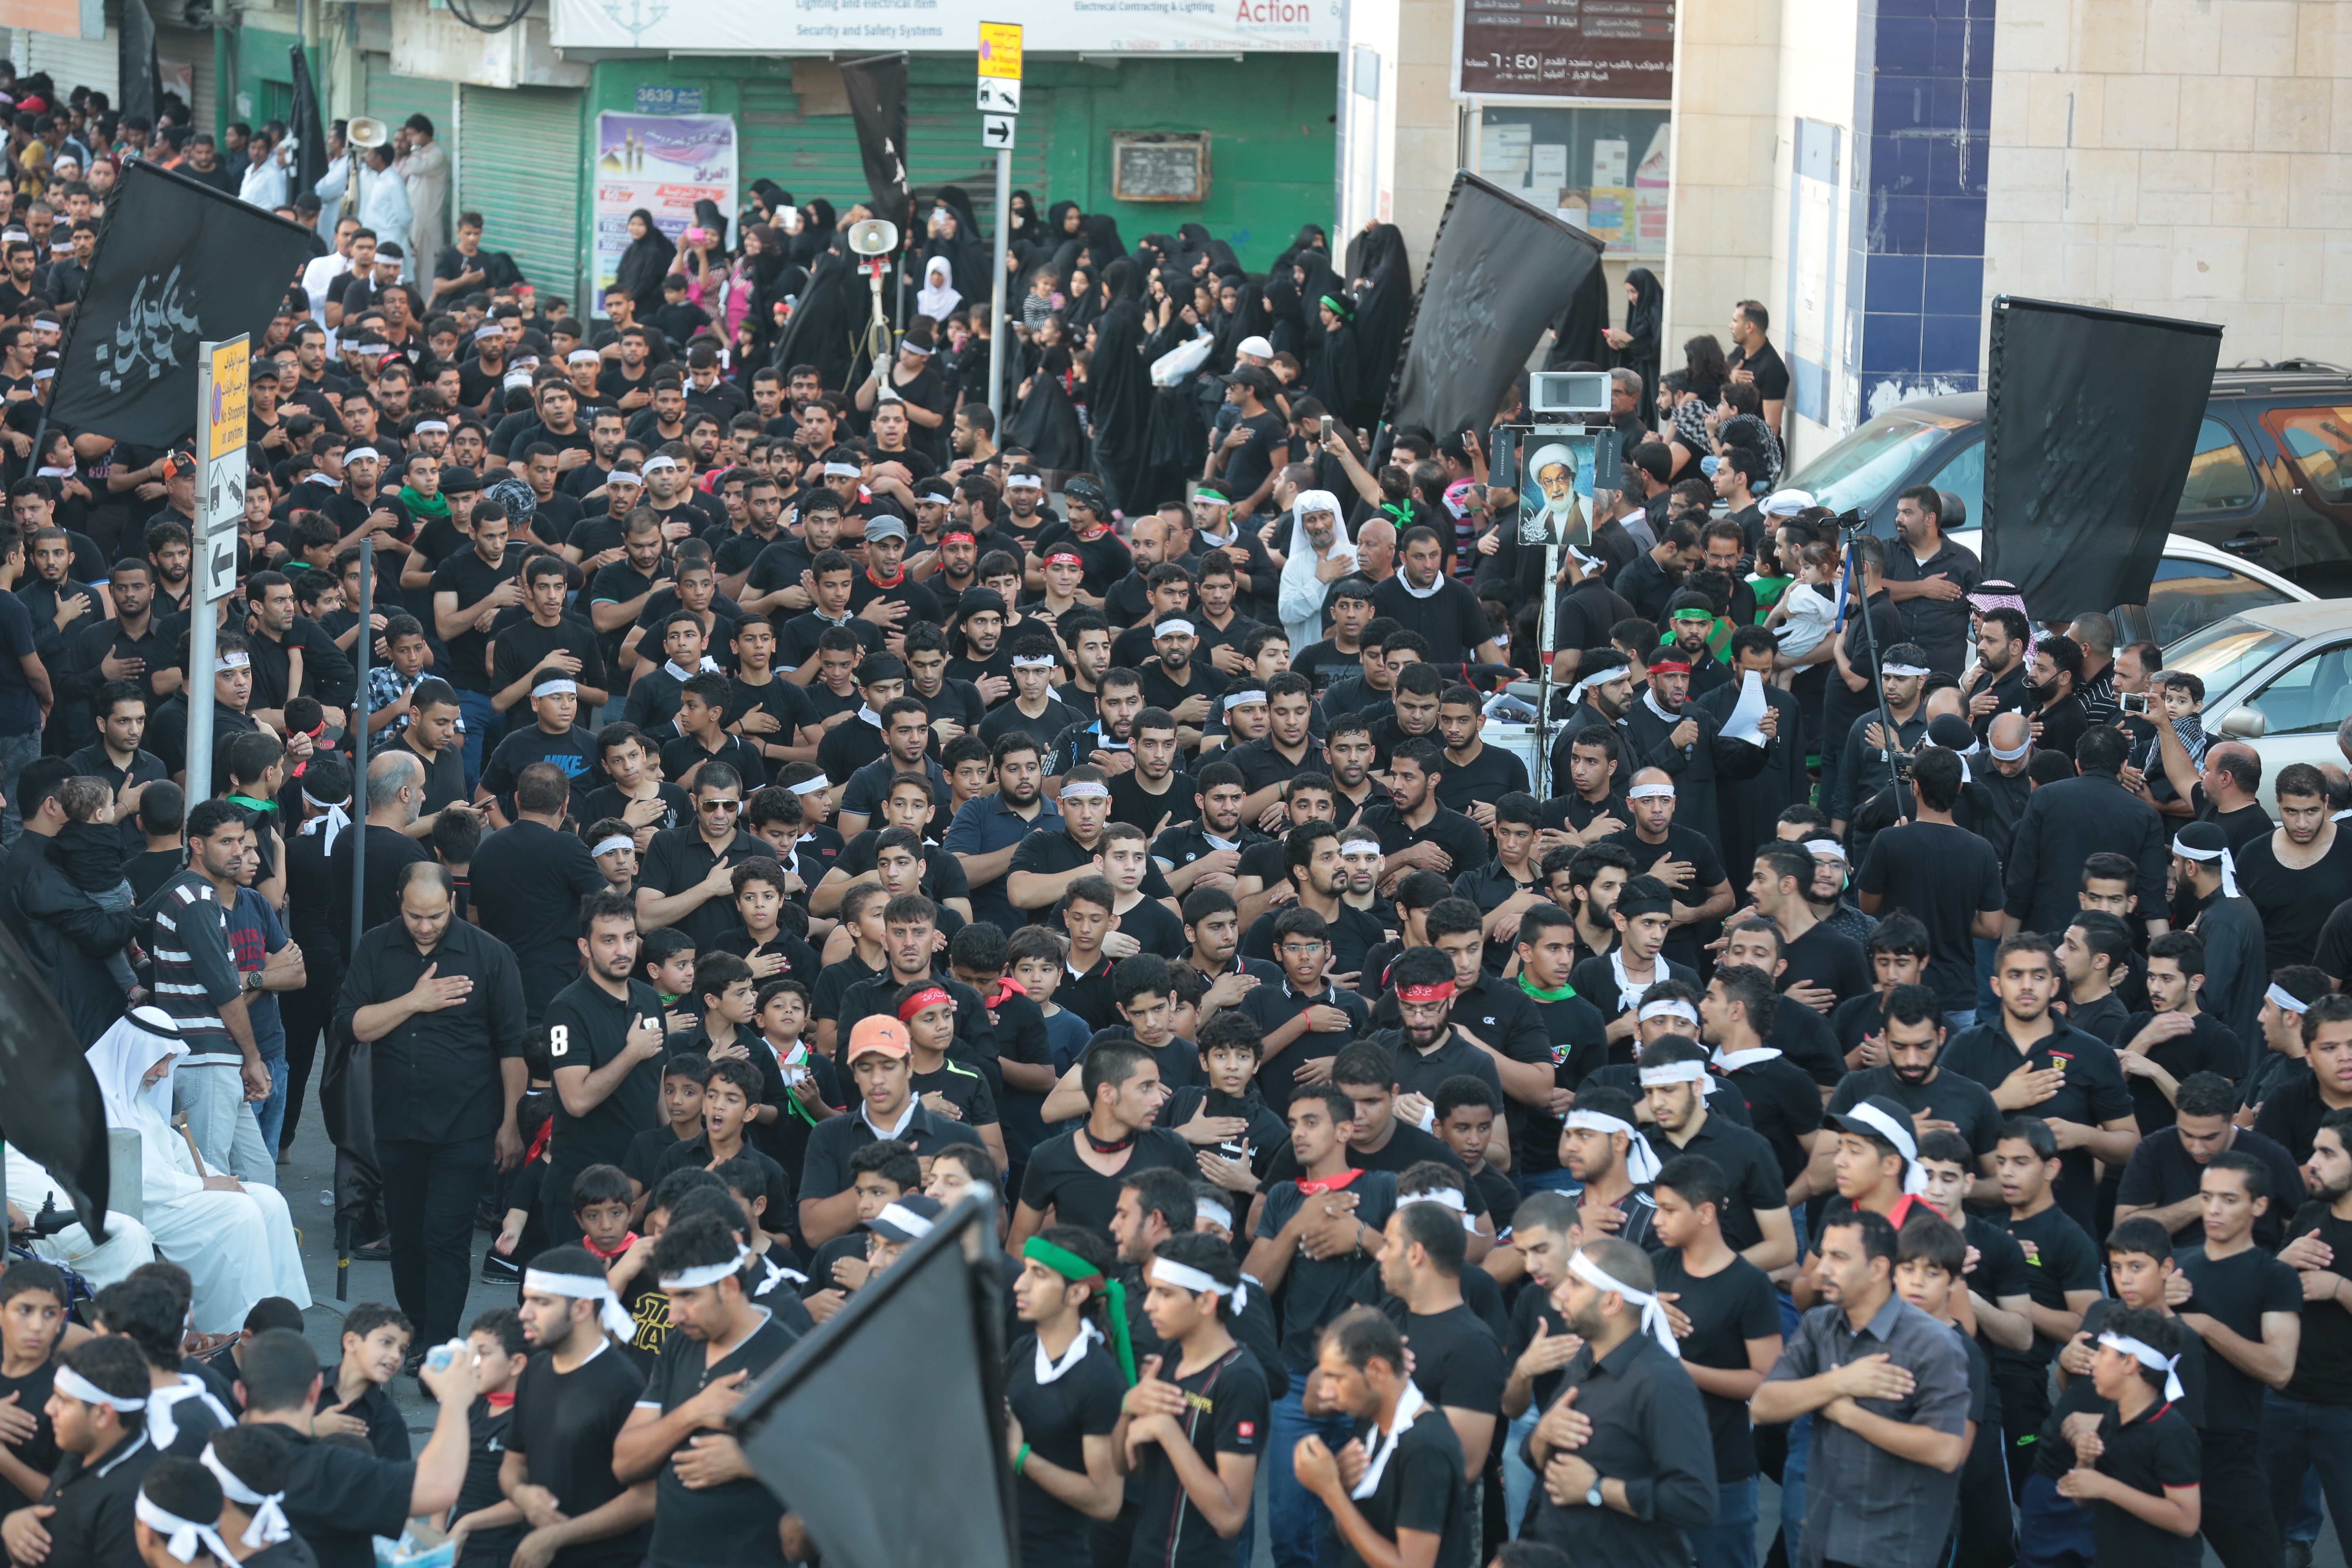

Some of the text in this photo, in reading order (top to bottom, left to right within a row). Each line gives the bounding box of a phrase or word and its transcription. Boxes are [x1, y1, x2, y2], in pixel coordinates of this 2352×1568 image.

[842, 0, 860, 8] and
[1120, 1, 1168, 13] Contracting
[1180, 1, 1214, 13] Lighting
[1236, 0, 1310, 22] Action
[1667, 4, 1674, 14] 6
[1546, 15, 1558, 25] 11
[796, 24, 942, 38] Security and Safety Systems
[1667, 23, 1674, 33] 7
[1568, 60, 1593, 68] مسجد
[1595, 60, 1608, 69] من
[637, 88, 674, 102] 3639
[694, 165, 729, 181] العراق
[604, 189, 619, 200] 60
[224, 352, 246, 372] ممنوع الوقوف
[220, 402, 245, 424] No Stopping
[222, 424, 243, 444] at anytime
[543, 755, 583, 773] NIKE
[230, 929, 258, 947] OUCH
[1483, 1016, 1496, 1025] GK
[550, 1025, 568, 1057] 8
